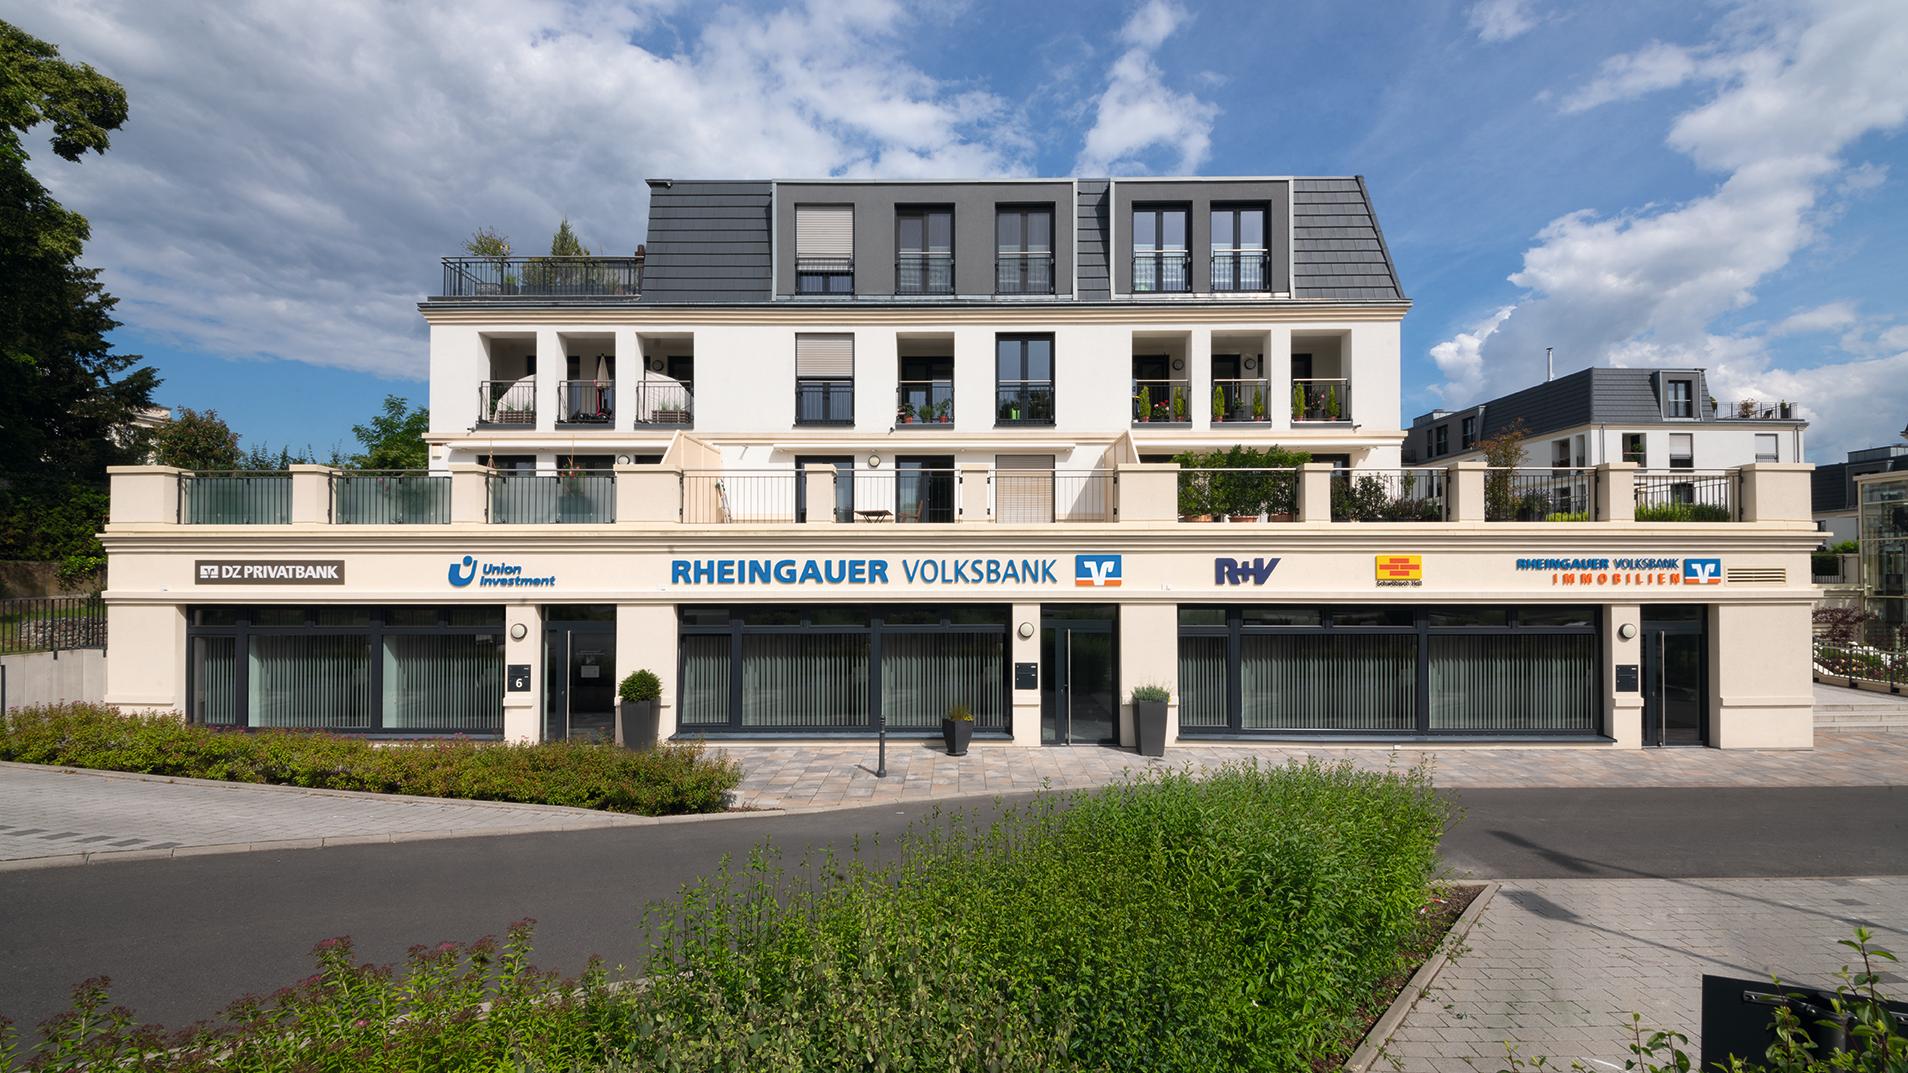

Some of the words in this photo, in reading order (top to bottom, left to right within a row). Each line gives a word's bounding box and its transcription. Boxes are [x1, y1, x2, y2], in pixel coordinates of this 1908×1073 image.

[482, 563, 522, 575] Union
[1516, 558, 1609, 571] RHEINGAUER
[1613, 558, 1679, 570] VOLKSBANK
[222, 565, 242, 579] DZ
[244, 565, 339, 579] PRIVATBANK
[672, 560, 888, 584] RHEINGAUER
[902, 560, 1058, 584] VOLKSBANK
[1215, 558, 1281, 585] R+V
[480, 575, 556, 587] Investment
[1552, 573, 1681, 586] IMMOBILIEN
[516, 678, 523, 688] 6
